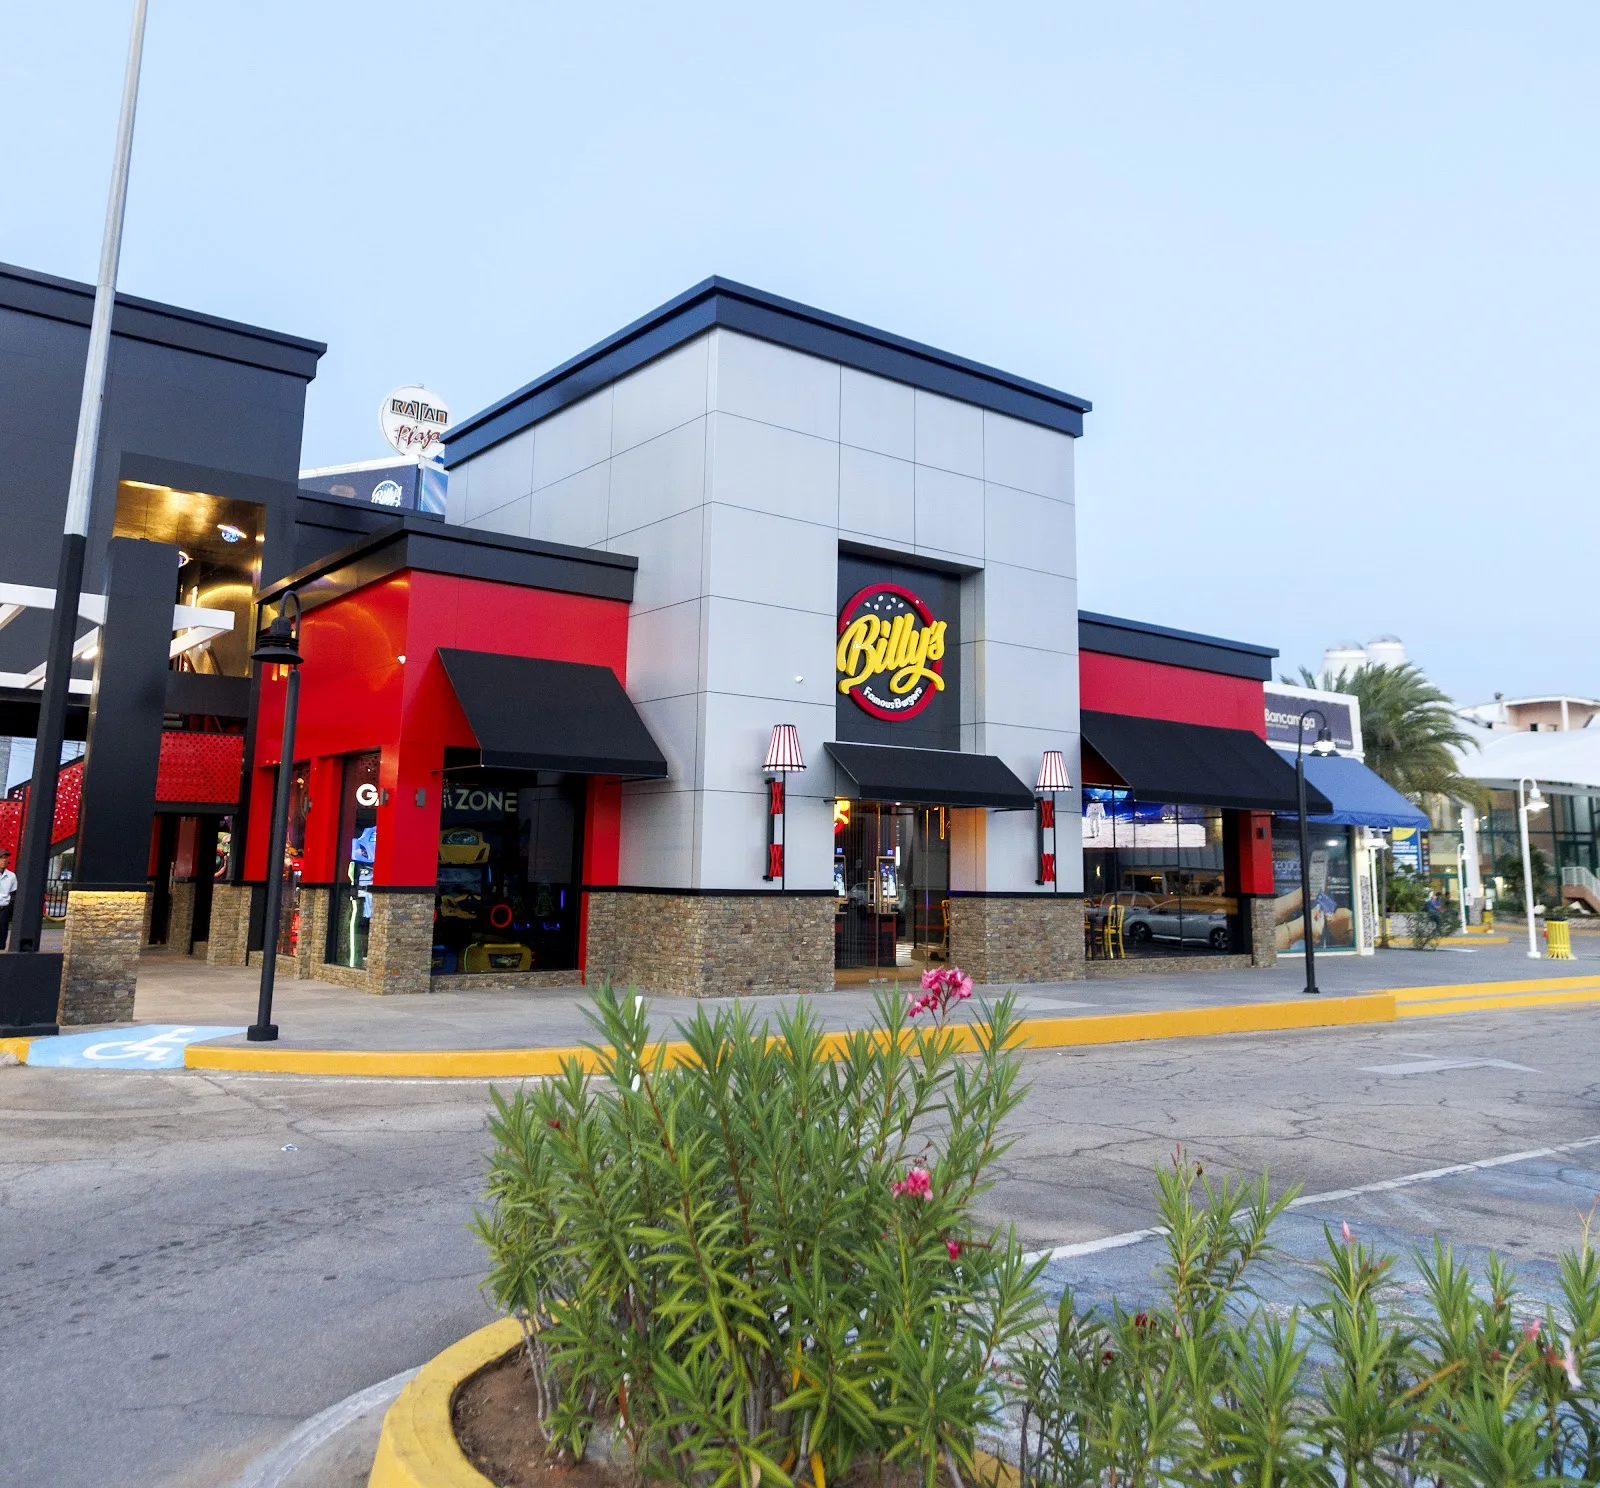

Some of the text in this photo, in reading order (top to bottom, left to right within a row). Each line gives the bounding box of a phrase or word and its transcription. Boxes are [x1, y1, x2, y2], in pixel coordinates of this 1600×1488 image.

[394, 425, 440, 450] Plaza
[836, 613, 947, 694] Billy's
[863, 686, 923, 709] Famous Burgers
[1264, 708, 1316, 730] Bancamga
[455, 788, 518, 812] ZONE
